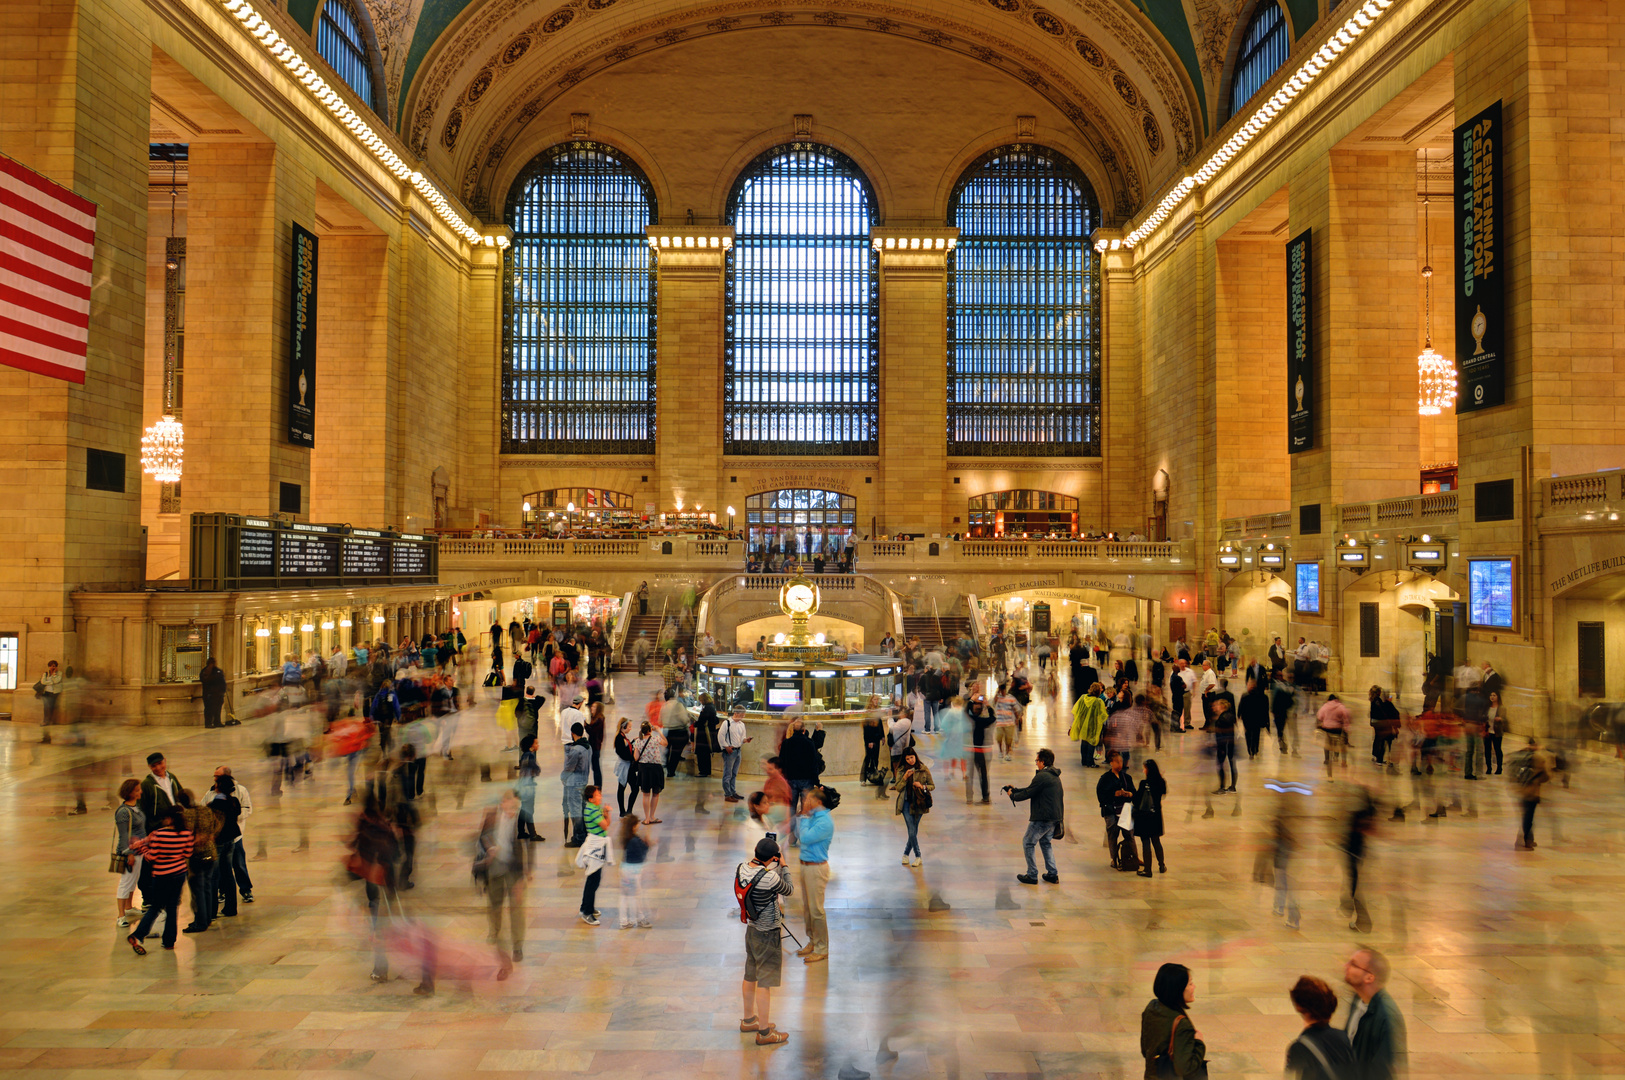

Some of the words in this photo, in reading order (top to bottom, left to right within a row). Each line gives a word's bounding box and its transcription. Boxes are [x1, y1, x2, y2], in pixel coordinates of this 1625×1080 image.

[1482, 119, 1492, 136] A
[1463, 129, 1473, 186] ISN'T
[1464, 193, 1473, 211] IT
[1473, 124, 1484, 277] CELEBRATION
[1483, 138, 1494, 279] CENTENNIAL
[1464, 216, 1474, 297] GRAND
[810, 482, 850, 492] APARTMENT
[818, 477, 846, 485] AVENUE
[459, 580, 488, 590] SUBWAY
[489, 577, 521, 585] SHUTTLE
[566, 579, 591, 587] STREET
[1080, 580, 1107, 588] TRACKS
[1550, 577, 1566, 592] THE
[1567, 562, 1601, 583] METLIFE
[992, 583, 1016, 592] TICKET
[1019, 580, 1056, 588] MACHINES
